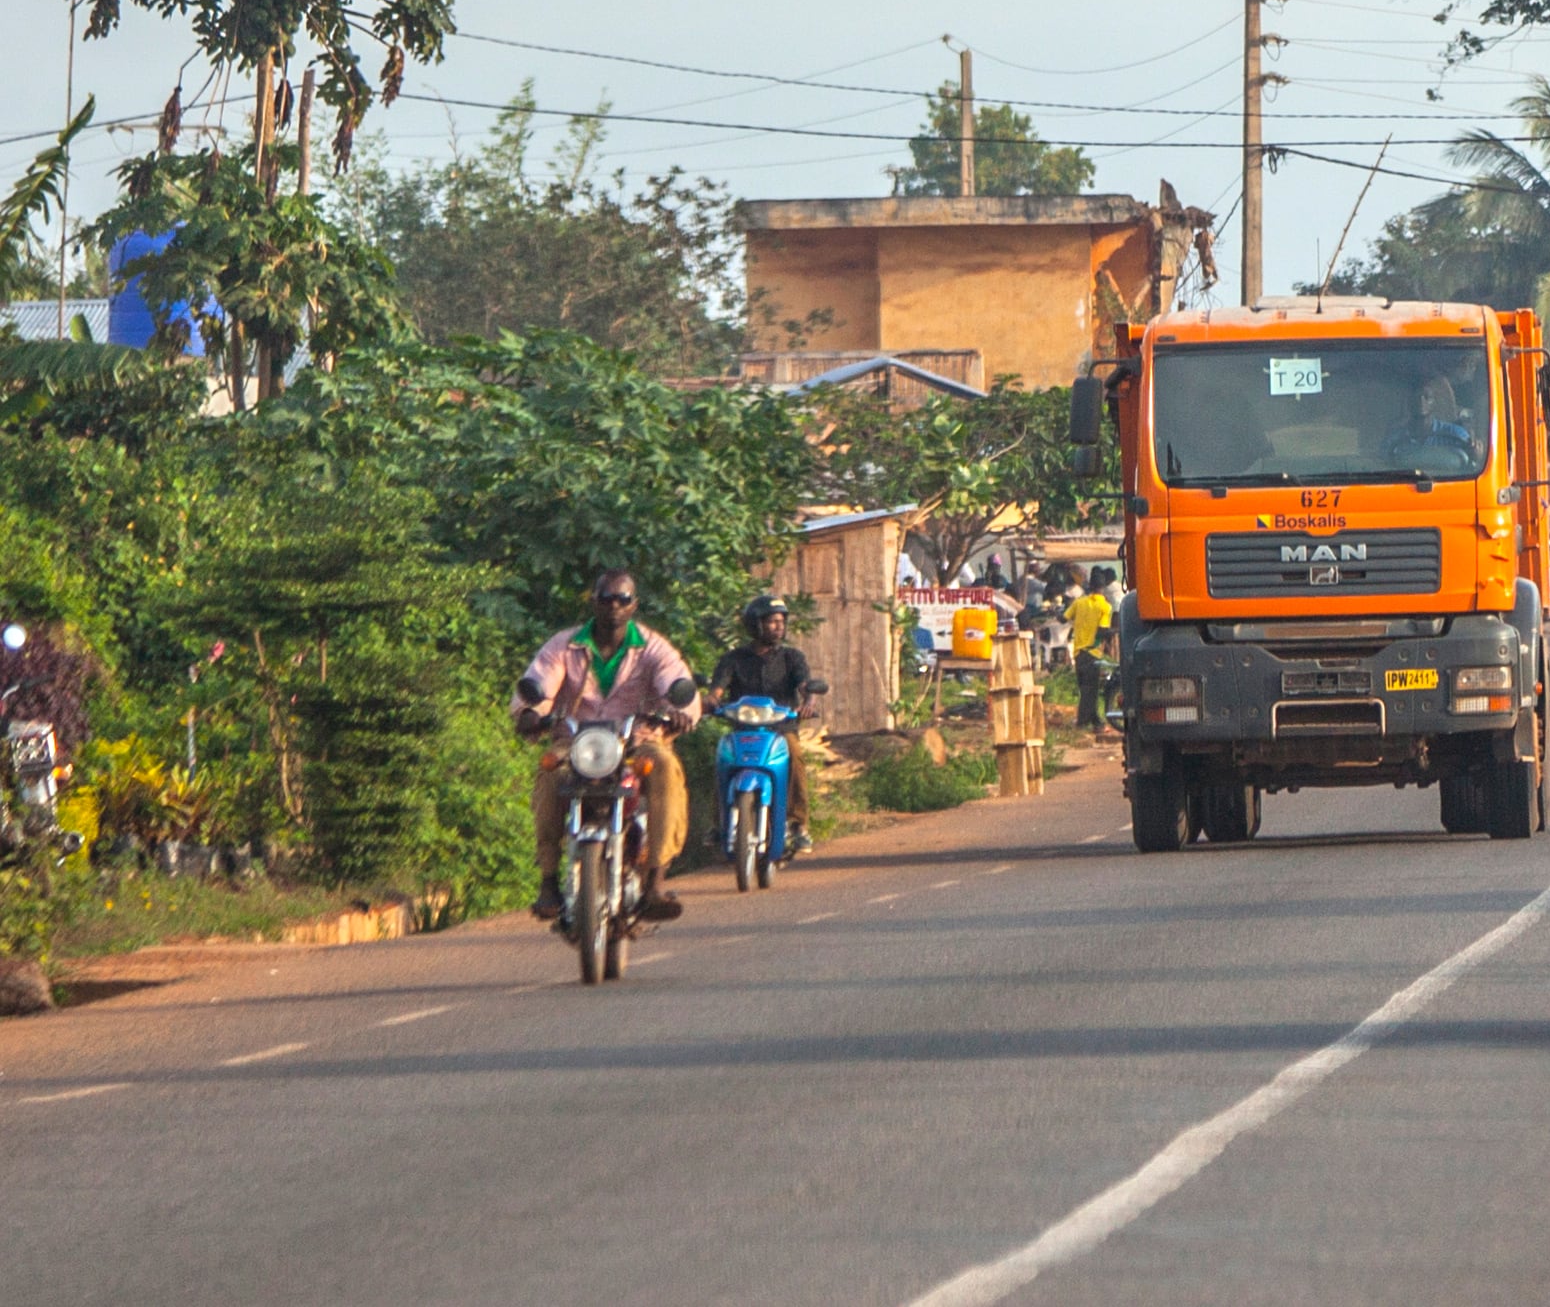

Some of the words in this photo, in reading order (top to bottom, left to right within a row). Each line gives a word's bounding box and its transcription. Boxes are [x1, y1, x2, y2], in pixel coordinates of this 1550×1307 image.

[1275, 372, 1286, 388] T
[1294, 371, 1318, 387] 20
[1301, 490, 1341, 508] 627
[1275, 514, 1346, 528] Boskalis
[1281, 544, 1366, 562] MAN
